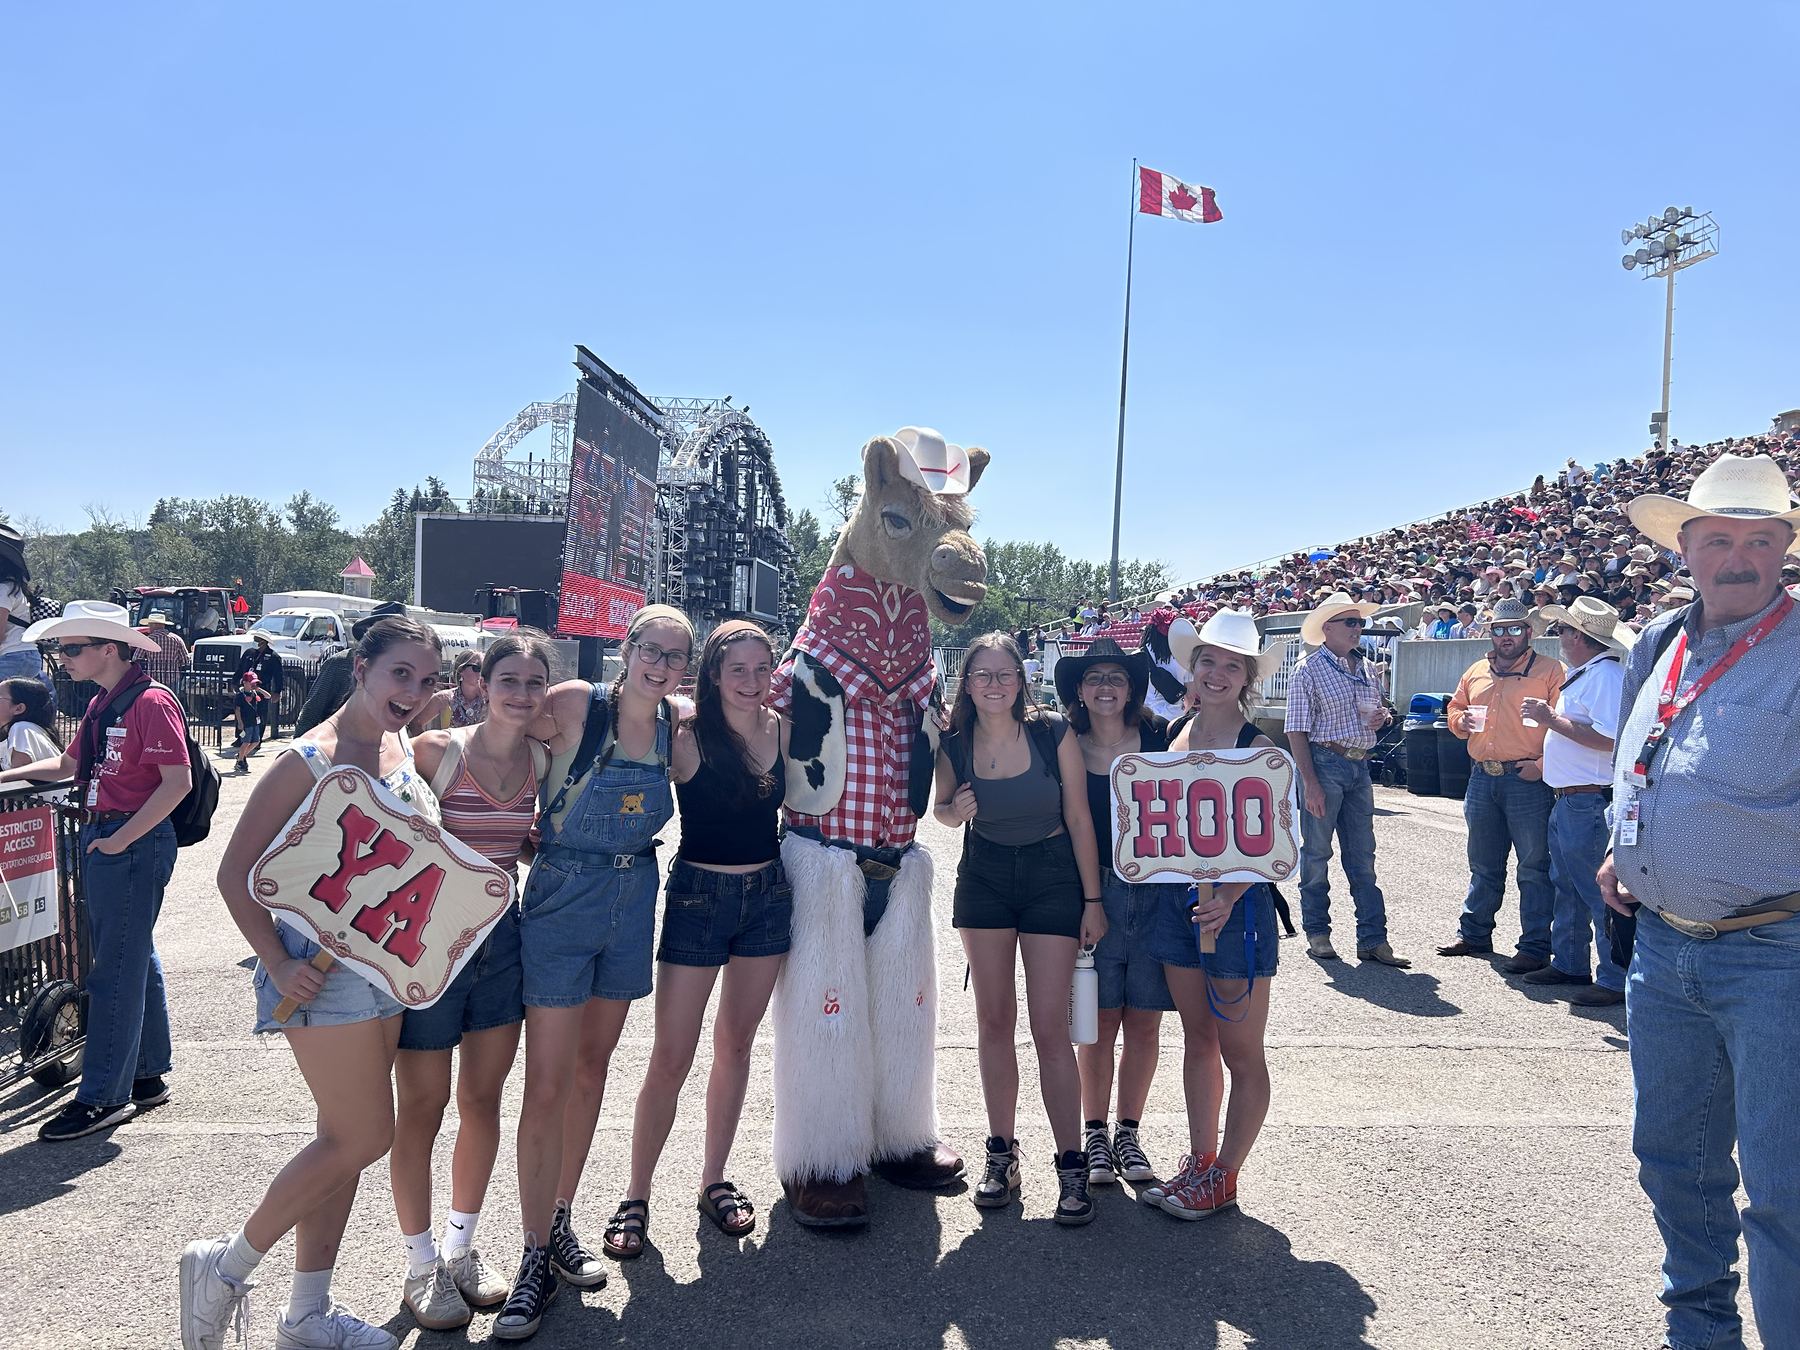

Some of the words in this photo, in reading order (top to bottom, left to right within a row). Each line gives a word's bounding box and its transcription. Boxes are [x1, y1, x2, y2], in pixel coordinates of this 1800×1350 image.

[1131, 776, 1275, 858] HOO
[0, 818, 43, 838] ESTRICTED
[3, 835, 35, 853] ACCESS
[27, 850, 52, 864] REQUIRED
[308, 803, 446, 968] YA
[36, 899, 45, 911] 13
